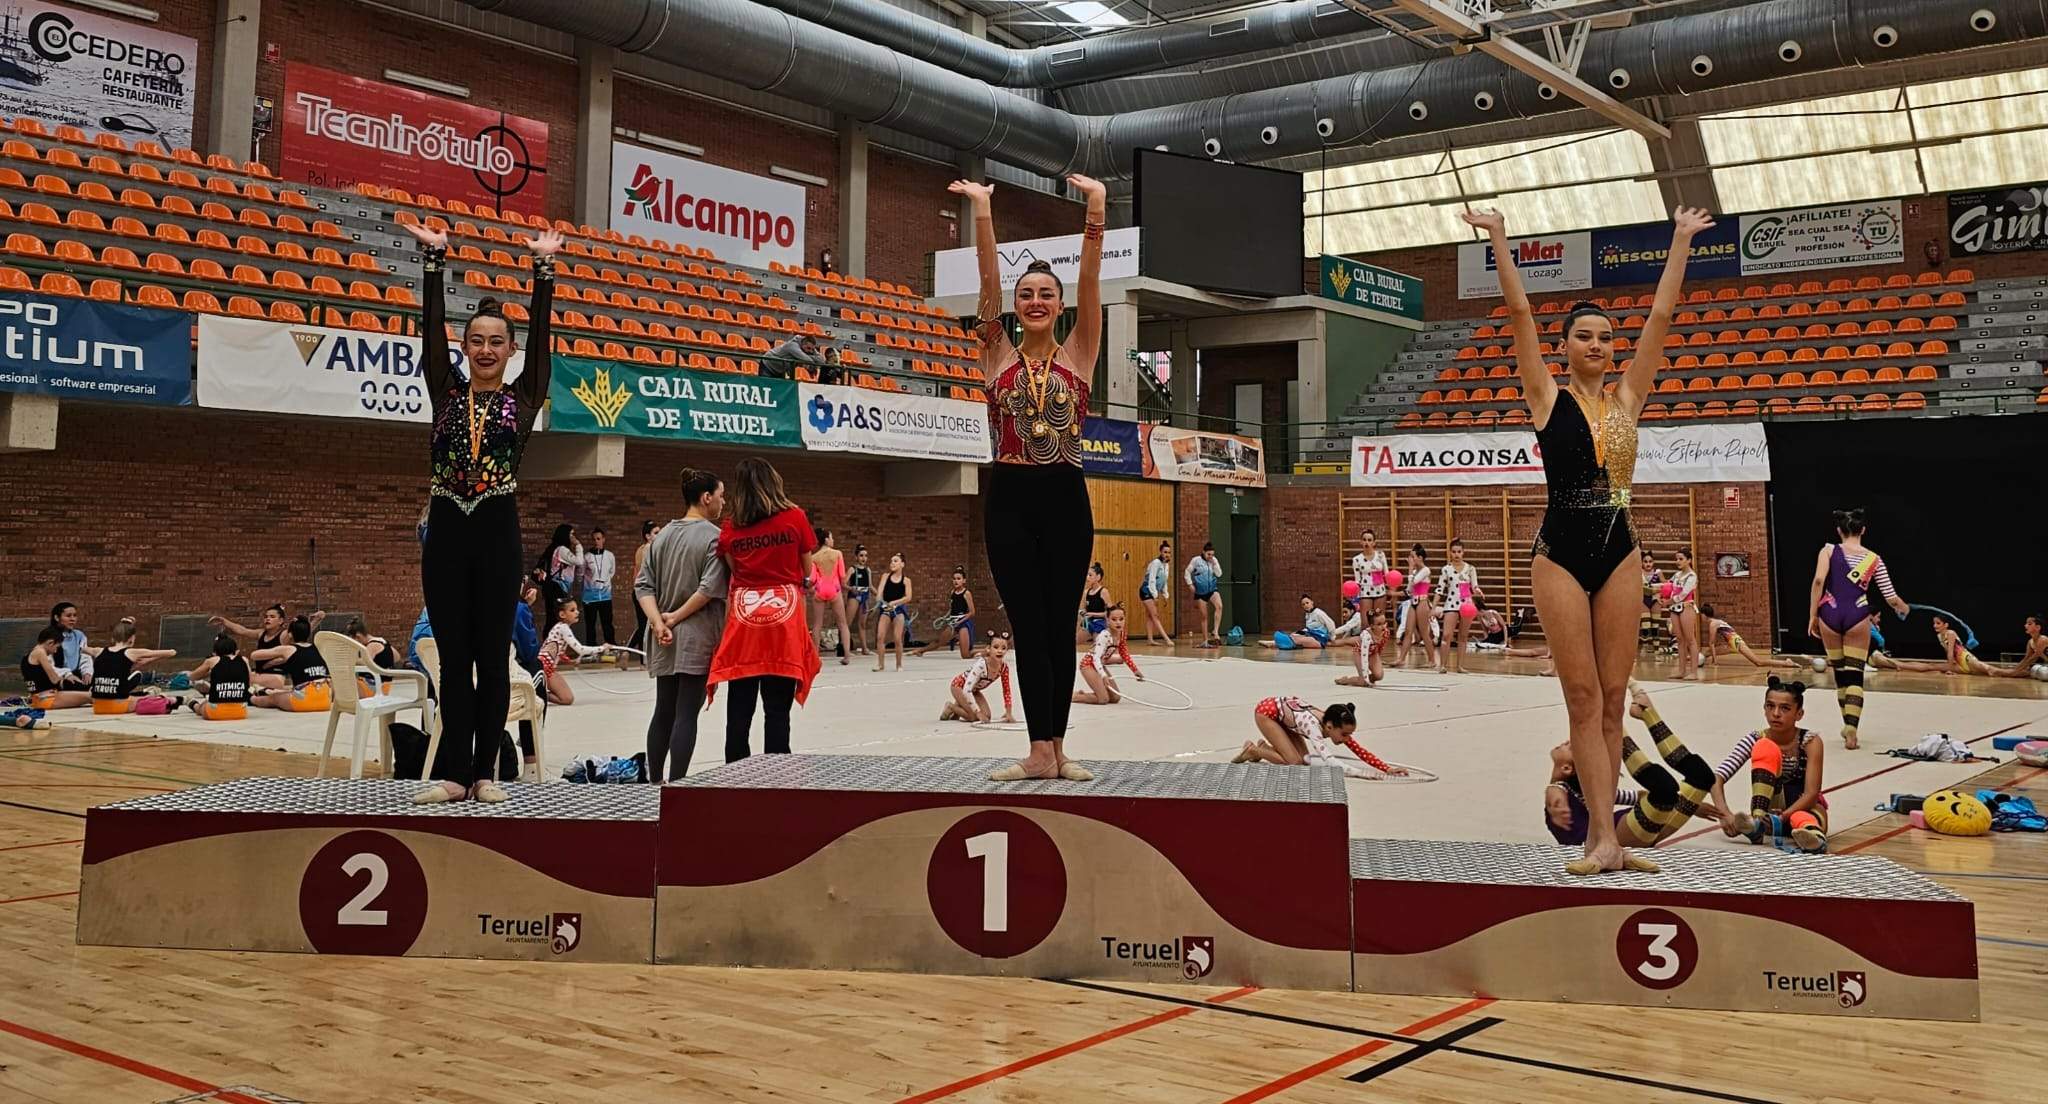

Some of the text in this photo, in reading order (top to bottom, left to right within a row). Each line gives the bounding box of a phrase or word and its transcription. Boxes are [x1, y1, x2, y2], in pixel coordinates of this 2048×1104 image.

[102, 84, 183, 110] RESTAURANTE
[297, 92, 514, 176] Tecnirótulo
[622, 163, 796, 252] Alcampo
[1751, 226, 1787, 244] CSIF
[1788, 224, 1850, 237] SEA CUAL SEA
[1812, 235, 1826, 243] TU
[1869, 226, 1888, 237] TU
[1951, 205, 2048, 253] Gim
[1753, 240, 1787, 249] TERUEL
[1743, 262, 1782, 272] SINDICATO
[1782, 257, 1841, 269] INDEPENDIENTE
[1848, 250, 1902, 264] PROFESIONAL
[1353, 268, 1406, 293] CAJA RURAL
[1527, 268, 1563, 279] Lozago
[1356, 287, 1404, 311] DE TERUEL
[295, 333, 318, 344] 1900
[50, 376, 97, 390] software
[98, 381, 156, 396] empresarial
[637, 374, 778, 409] CAJA RURAL
[645, 406, 775, 437] DE TERUEL
[836, 402, 982, 435] A&S CONSULTORES
[731, 531, 794, 552] PERSONAL
[337, 852, 389, 926] 2
[964, 831, 1008, 932] 1
[477, 913, 550, 937] Teruel
[505, 936, 550, 945] AYUNTAMIENTO
[1101, 936, 1181, 961] Teruel
[1637, 922, 1681, 981] 3
[1131, 960, 1181, 969] AYUNTAMIENTO
[1762, 970, 1837, 993] Teruel
[1792, 991, 1836, 1000] AYUNTAMIENTO
